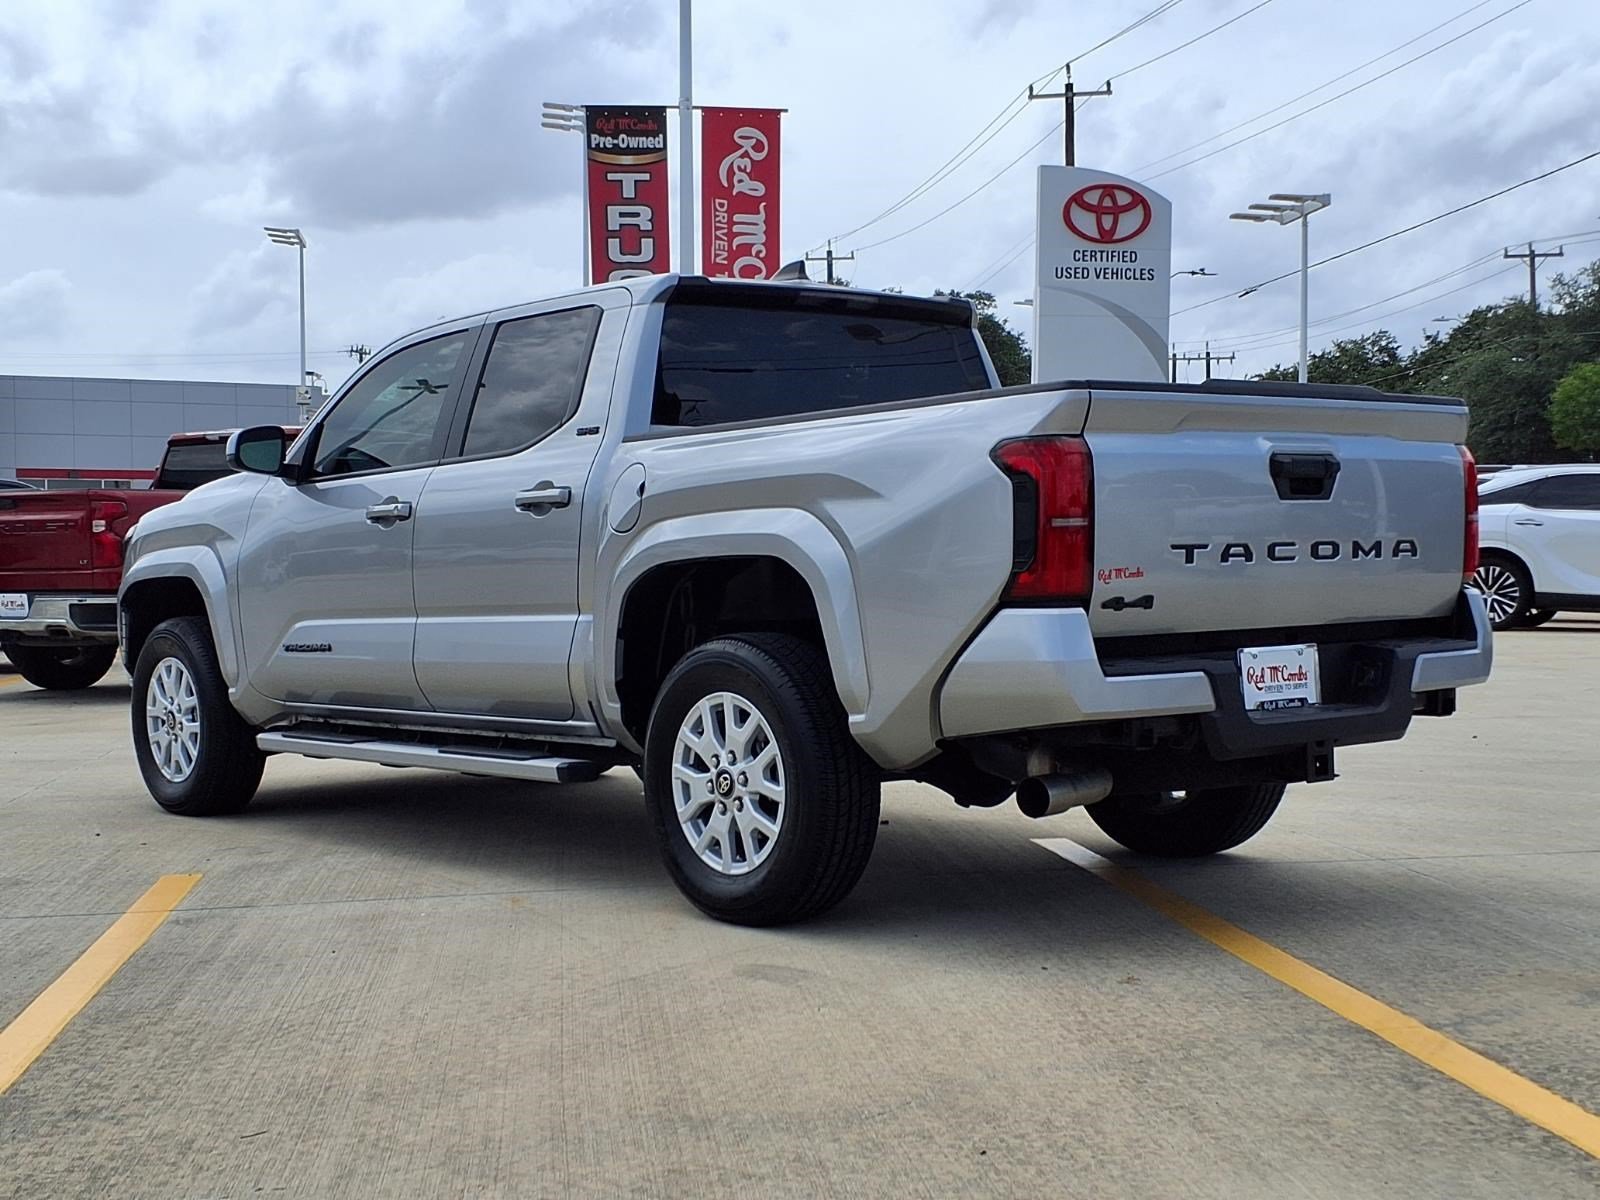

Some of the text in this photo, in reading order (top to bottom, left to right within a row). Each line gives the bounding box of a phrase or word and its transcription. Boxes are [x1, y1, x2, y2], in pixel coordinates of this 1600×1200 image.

[590, 133, 664, 149] Pre-Owned
[719, 127, 769, 197] Red
[714, 198, 729, 265] DRIVEN
[1073, 249, 1138, 263] CERTIFIED
[1055, 266, 1155, 281] USED VEHICLES
[1169, 539, 1419, 565] TACOMA
[1246, 664, 1308, 691] Red McCombs
[1264, 684, 1284, 693] DRIVEN
[1292, 682, 1308, 690] SERVE
